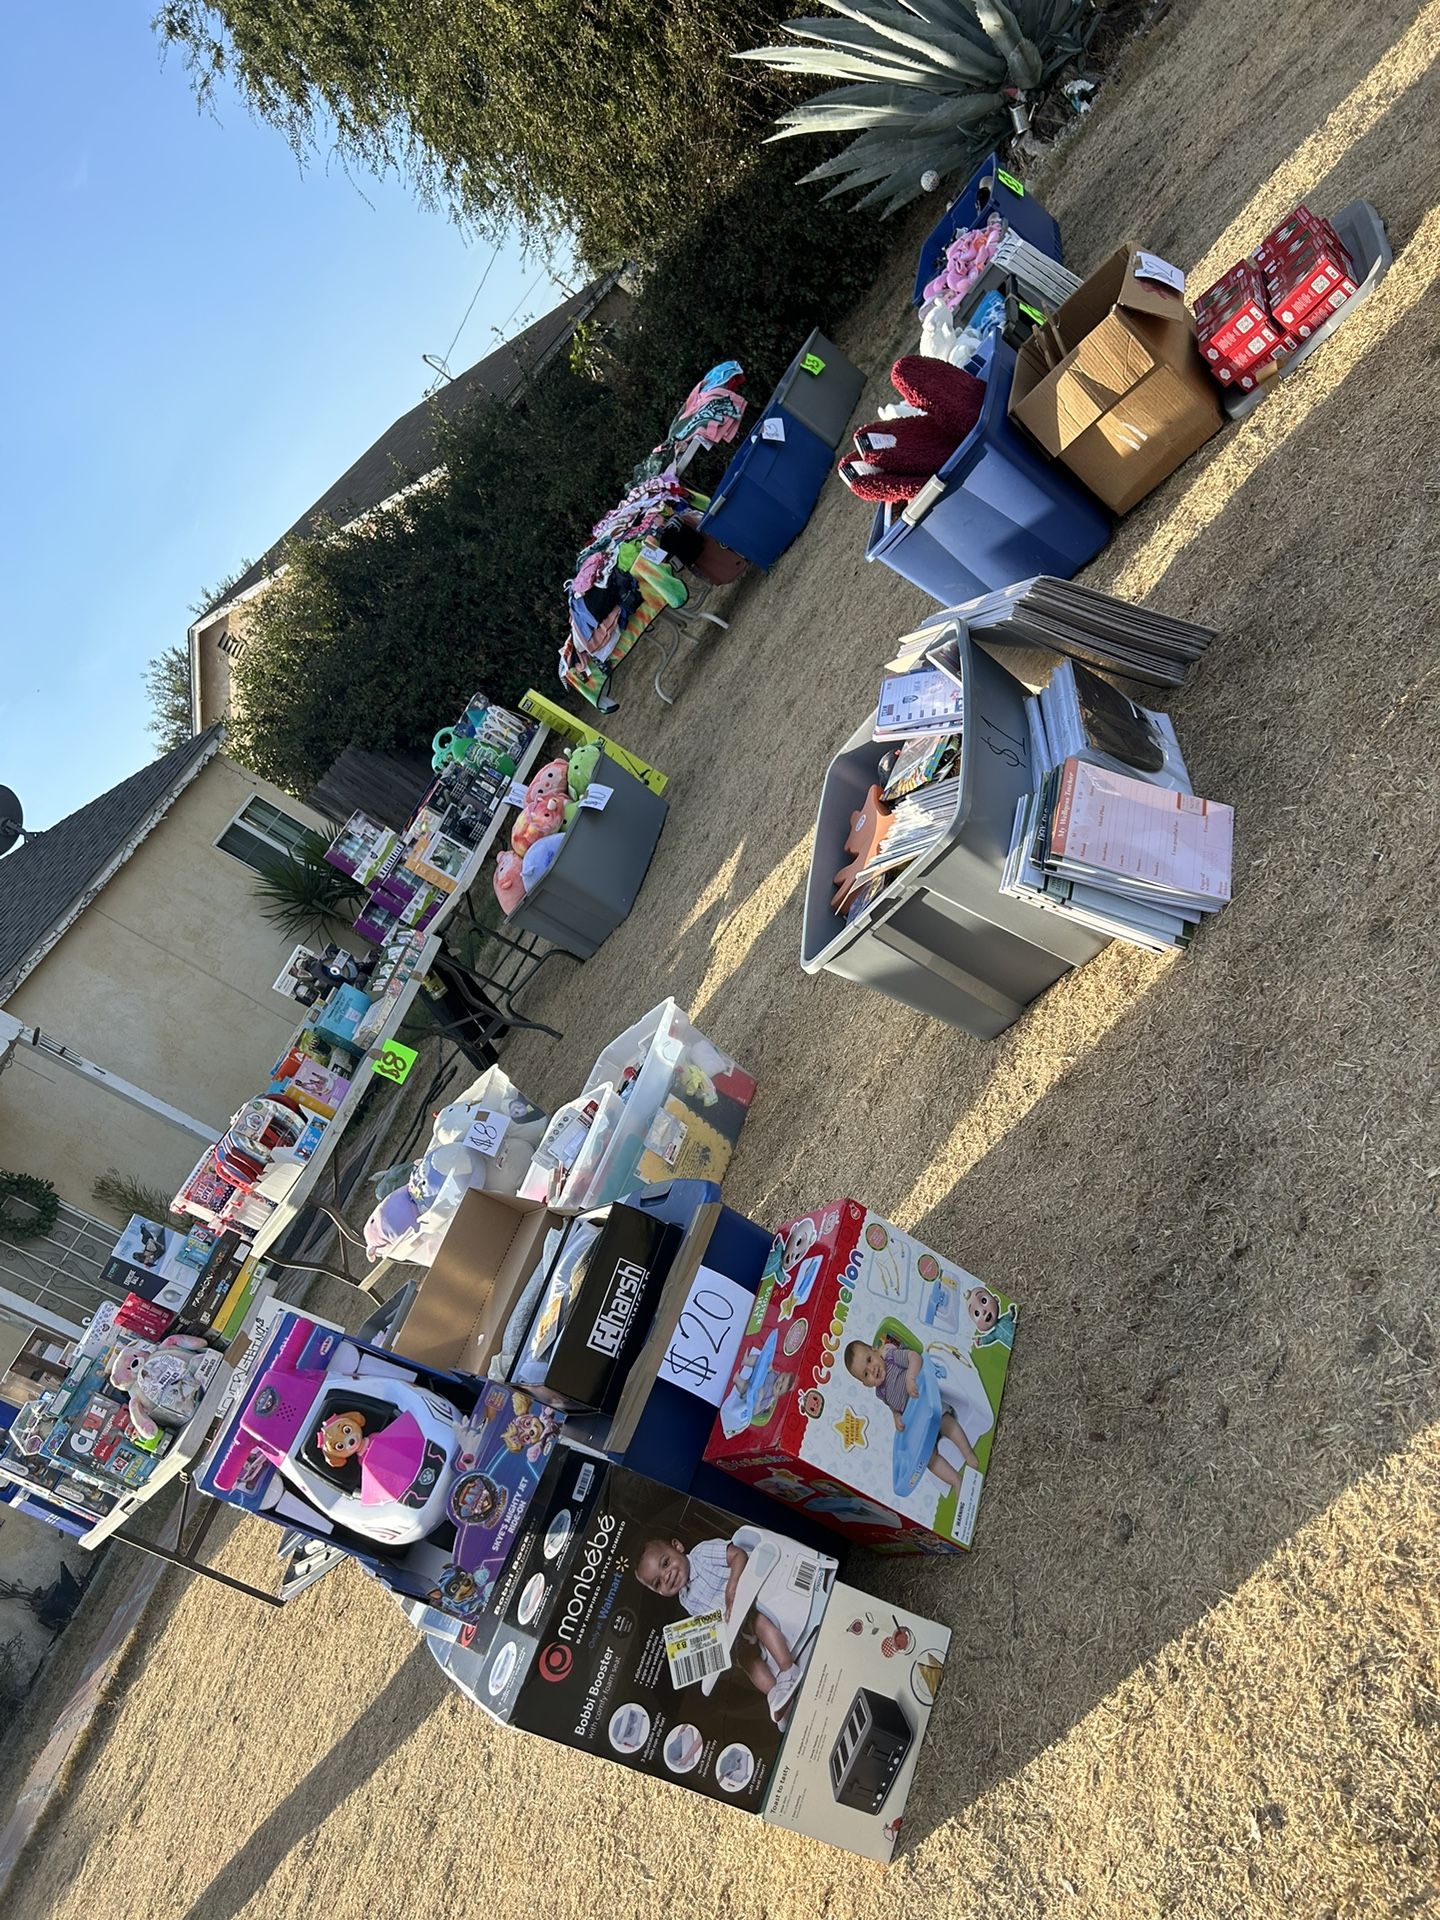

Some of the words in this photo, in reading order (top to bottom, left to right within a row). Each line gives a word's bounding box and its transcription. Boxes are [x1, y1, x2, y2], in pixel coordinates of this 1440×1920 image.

[975, 712, 1030, 773] $1
[1064, 770, 1076, 797] Tracker
[375, 1047, 410, 1081] $8
[467, 1117, 500, 1154] $8
[190, 1272, 213, 1308] FASHION
[599, 1259, 644, 1329] harsh
[808, 1246, 868, 1387] CoComelon
[658, 1281, 739, 1393] $20
[65, 1402, 108, 1457] CLUE
[490, 1521, 509, 1552] SKYE'S
[503, 1490, 523, 1524] MIGHTY
[517, 1475, 529, 1492] JET
[506, 1499, 528, 1534] RIDE-ON
[955, 1500, 966, 1527] WARNING
[493, 1571, 514, 1615] Bobbi
[554, 1509, 618, 1642] monbébé
[575, 1621, 588, 1644] BABY
[583, 1584, 602, 1622] INSPIRED
[599, 1554, 613, 1580] STYLE
[609, 1520, 627, 1555] ADMIRED
[597, 1569, 624, 1622] Walmart
[610, 1654, 622, 1674] seat
[573, 1695, 596, 1737] Bobbi
[587, 1644, 615, 1697] Booster
[601, 1671, 616, 1694] foam
[592, 1692, 609, 1722] comfy
[586, 1719, 599, 1740] with
[776, 1783, 784, 1794] to
[779, 1764, 791, 1785] tasty
[769, 1793, 781, 1815] Toast
